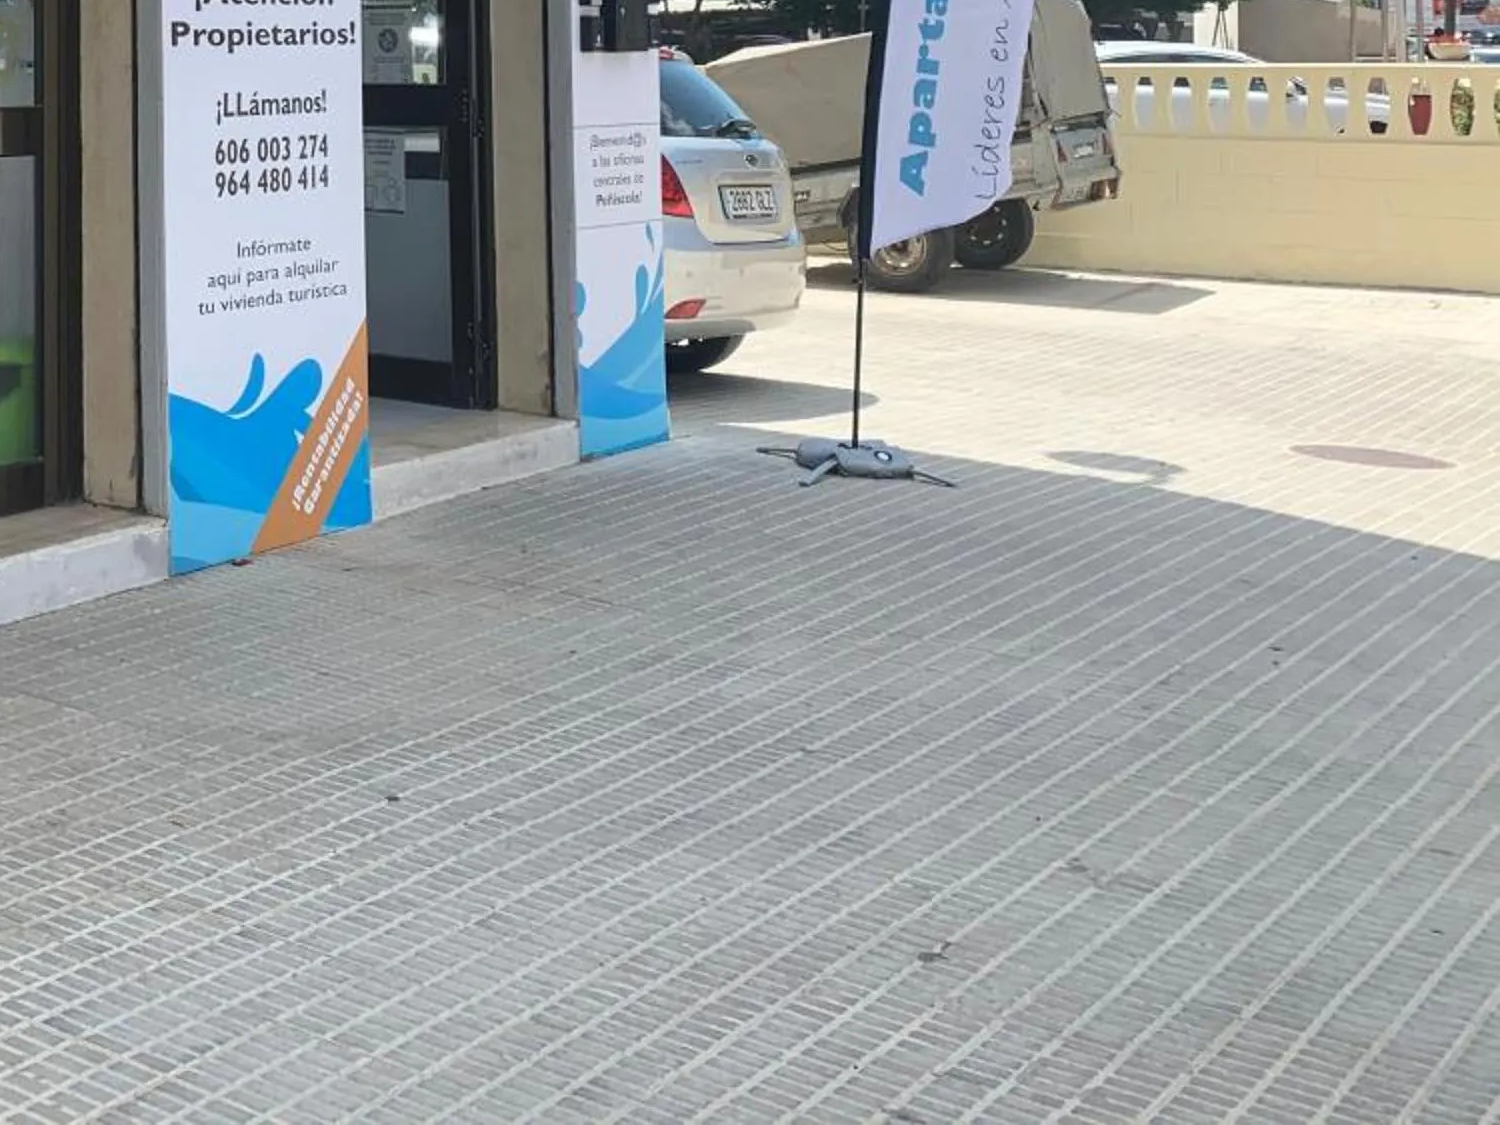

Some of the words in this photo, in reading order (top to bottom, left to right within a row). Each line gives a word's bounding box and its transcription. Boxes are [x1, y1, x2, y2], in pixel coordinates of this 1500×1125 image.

[170, 21, 356, 54] Propietarios!
[972, 75, 1005, 200] Líderes
[990, 19, 1010, 62] en
[214, 138, 250, 166] 606
[256, 136, 292, 163] 003
[298, 134, 329, 160] 274
[214, 170, 251, 199] 964
[257, 166, 293, 194] 480
[297, 164, 330, 190] 414
[236, 238, 313, 259] Infórmate
[206, 271, 242, 291] aquí
[246, 268, 280, 288] para
[285, 258, 340, 282] alquilar
[198, 300, 215, 315] tu
[220, 289, 284, 313] vivienda
[288, 281, 348, 307] turística
